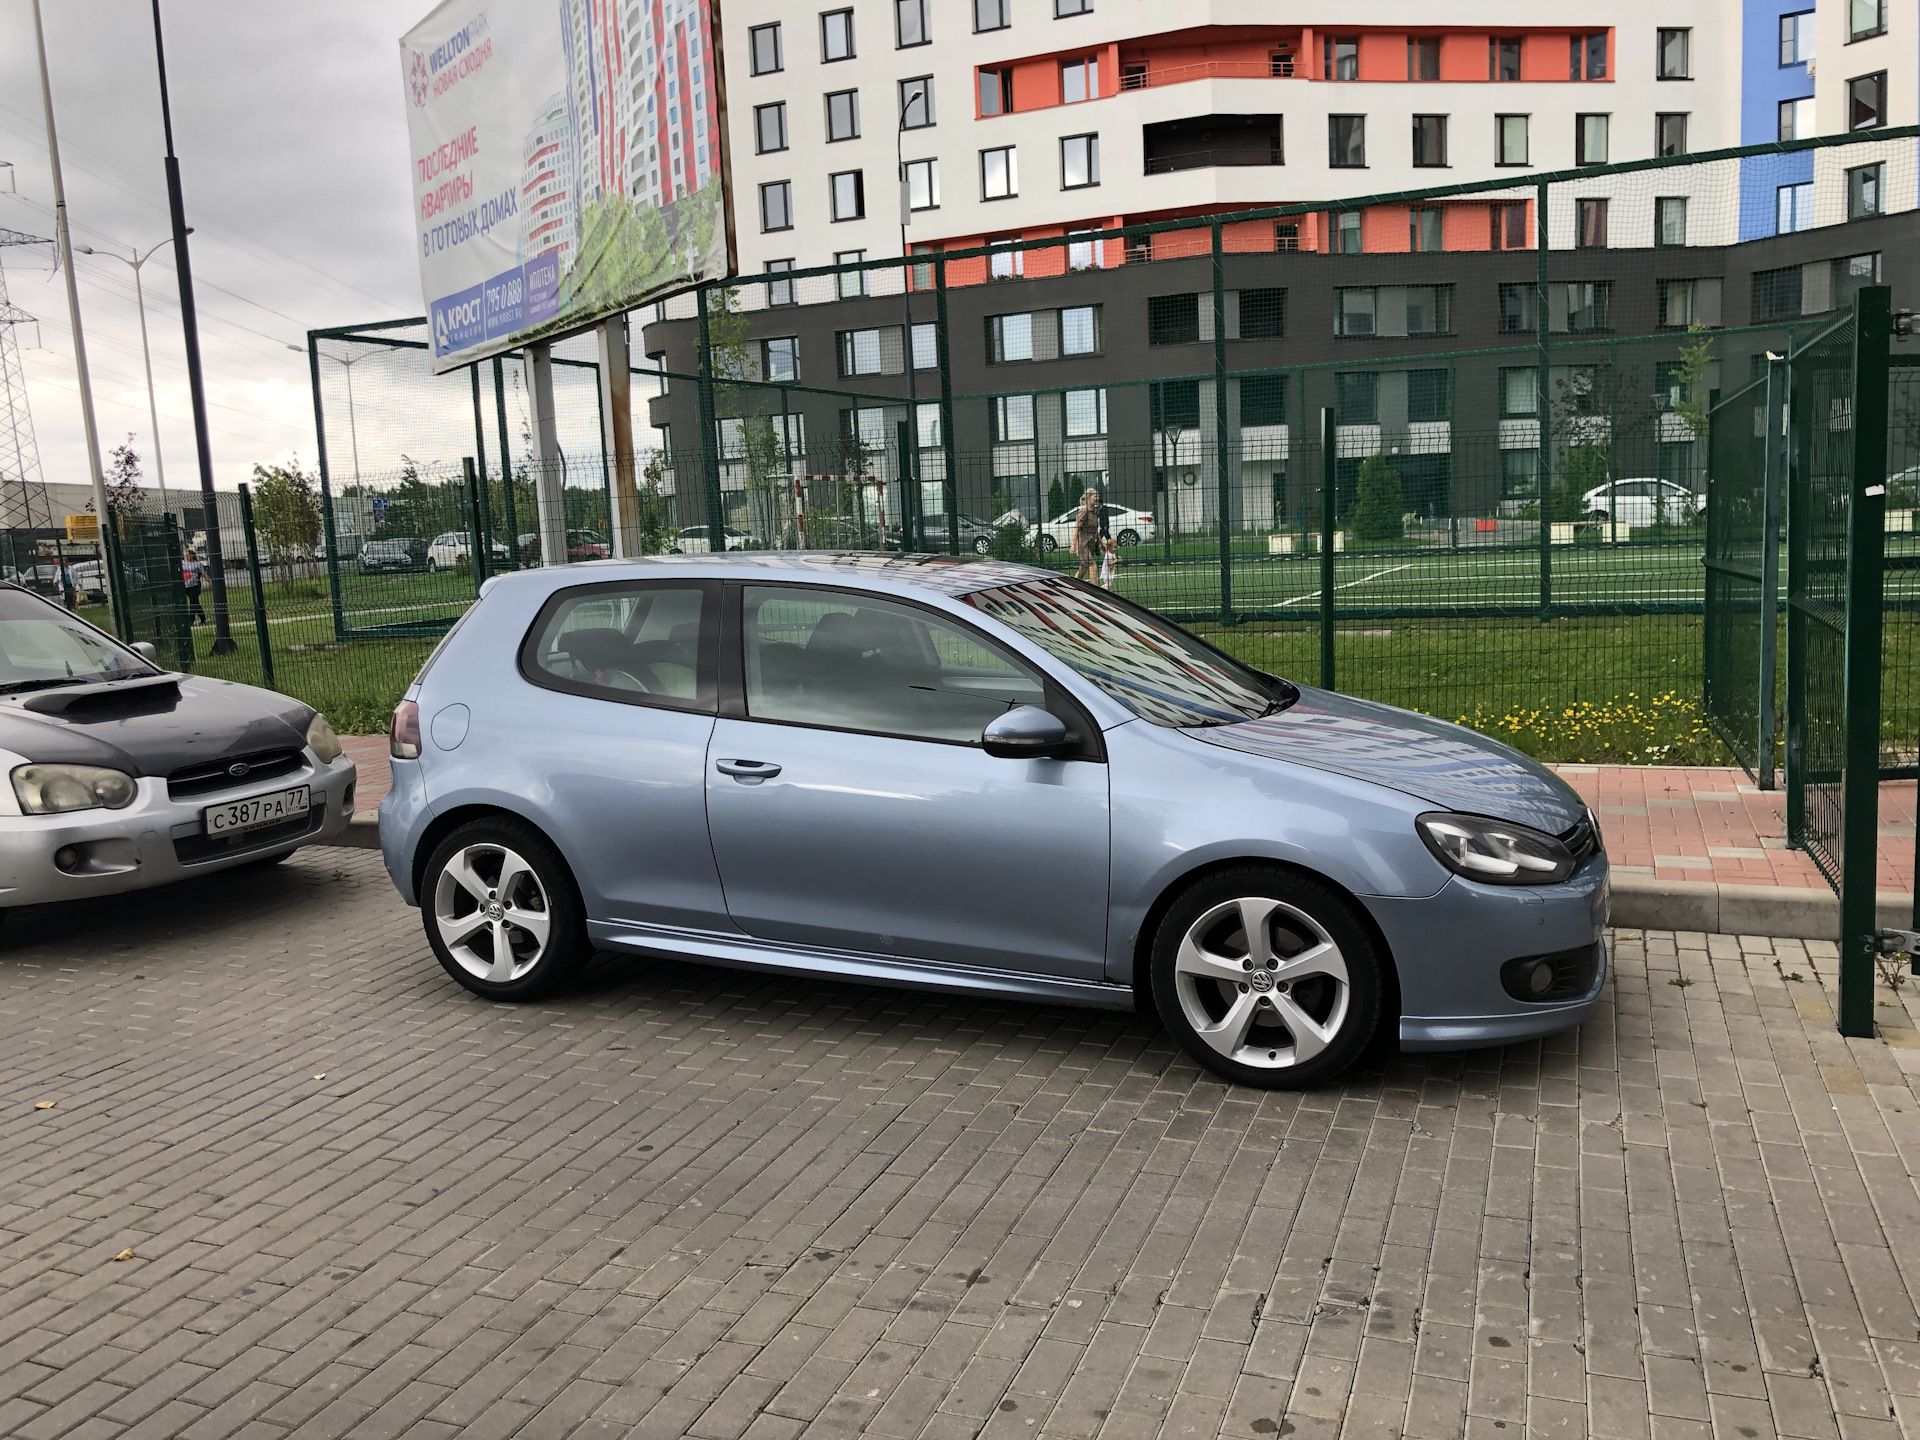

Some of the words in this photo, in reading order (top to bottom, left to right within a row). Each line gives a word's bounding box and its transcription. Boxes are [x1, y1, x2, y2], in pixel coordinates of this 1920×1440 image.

[433, 65, 458, 99] НОВАЯ
[459, 37, 492, 80] СХОДНЯ
[417, 125, 479, 184] ПОСЛЕДНИЕ
[420, 170, 473, 221] КВАРТИРЫ
[423, 232, 430, 258] В
[431, 207, 480, 254] ГОТОВЫХ
[480, 186, 518, 238] ДОМАХ
[486, 286, 501, 315] 795
[507, 277, 523, 307] 888
[529, 263, 556, 291] ИПОТЕКА
[447, 297, 481, 331] КРОСТ
